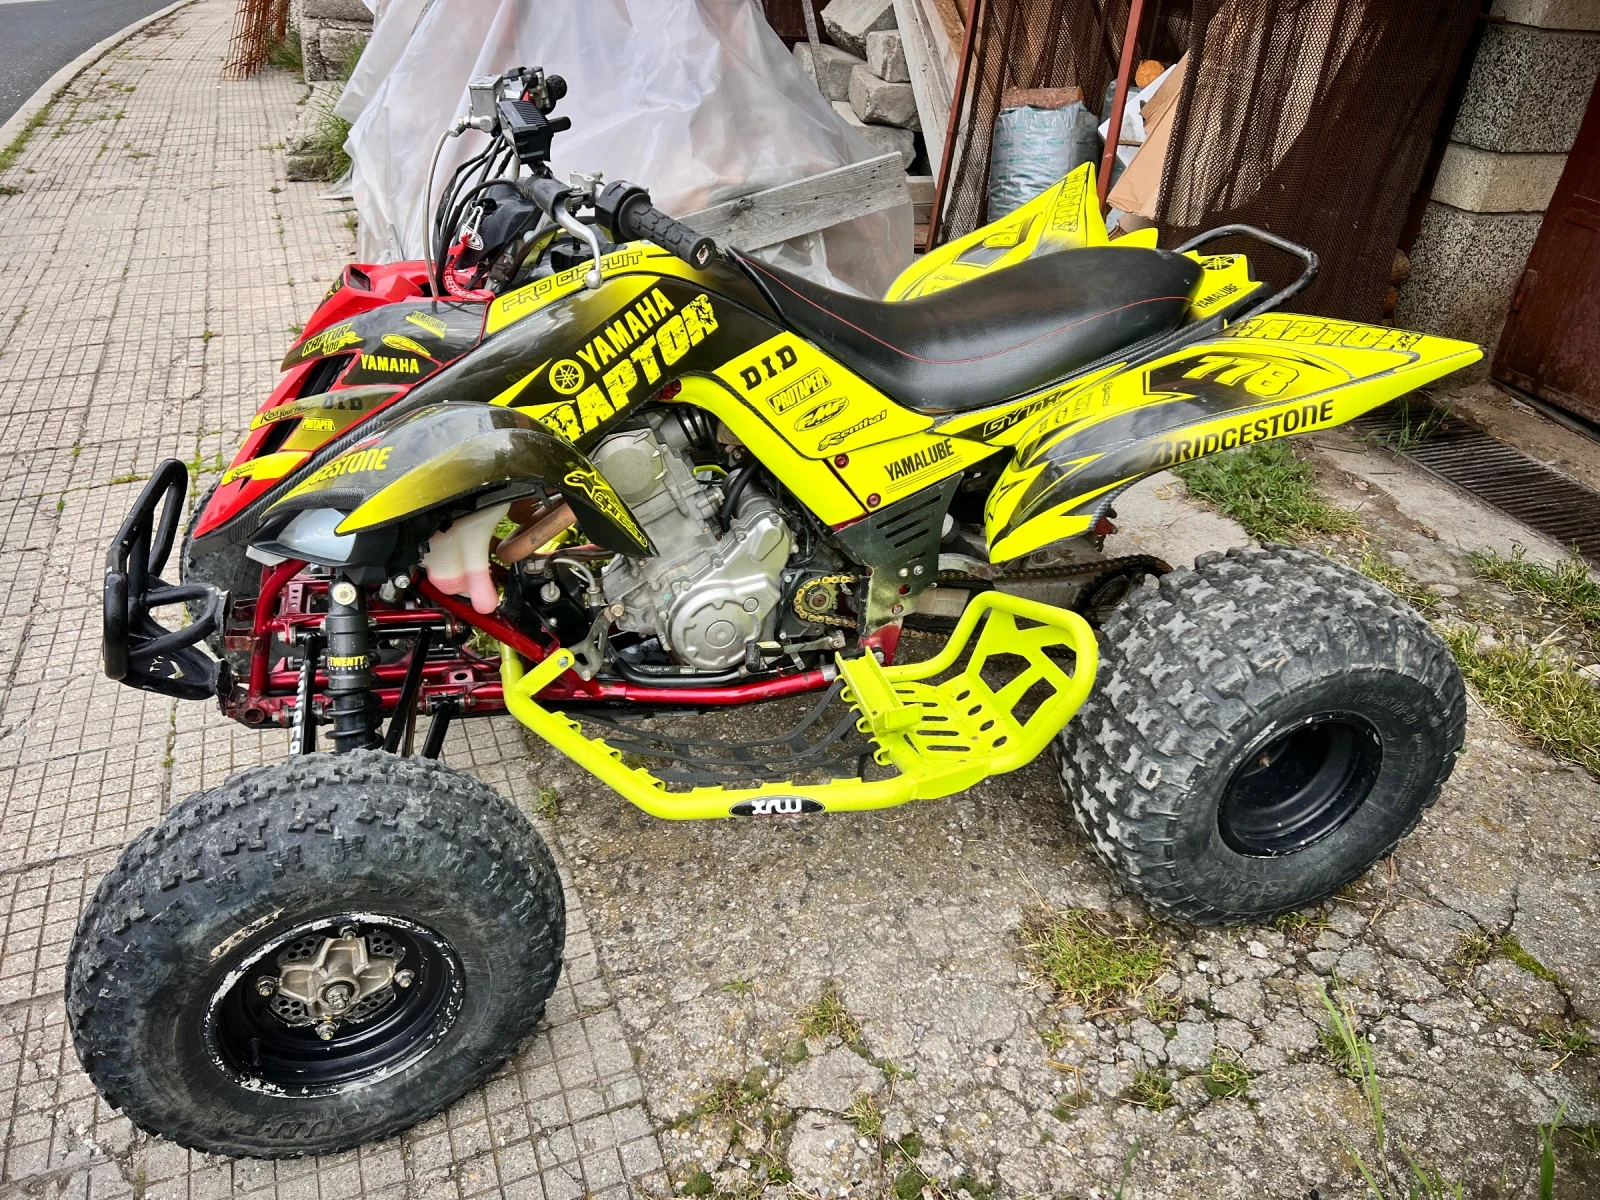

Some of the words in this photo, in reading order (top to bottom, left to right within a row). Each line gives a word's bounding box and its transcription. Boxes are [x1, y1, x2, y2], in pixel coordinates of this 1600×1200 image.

[502, 282, 552, 312] PRO
[1195, 283, 1242, 308] YAMALUBE
[302, 323, 353, 356] RAPTOR
[576, 288, 675, 372] YAMAHA
[1228, 318, 1424, 352] RAPTOR
[361, 353, 420, 374] YAMAHA
[538, 293, 719, 442] RAPTOR
[1182, 355, 1300, 397] 778
[772, 370, 831, 413] PROTAPER
[796, 397, 849, 431] FMF
[817, 408, 888, 452] Renthal
[982, 389, 1063, 438] GYTR
[1151, 399, 1334, 467] BRIDGESTONE
[884, 438, 955, 481] YAMALUBE
